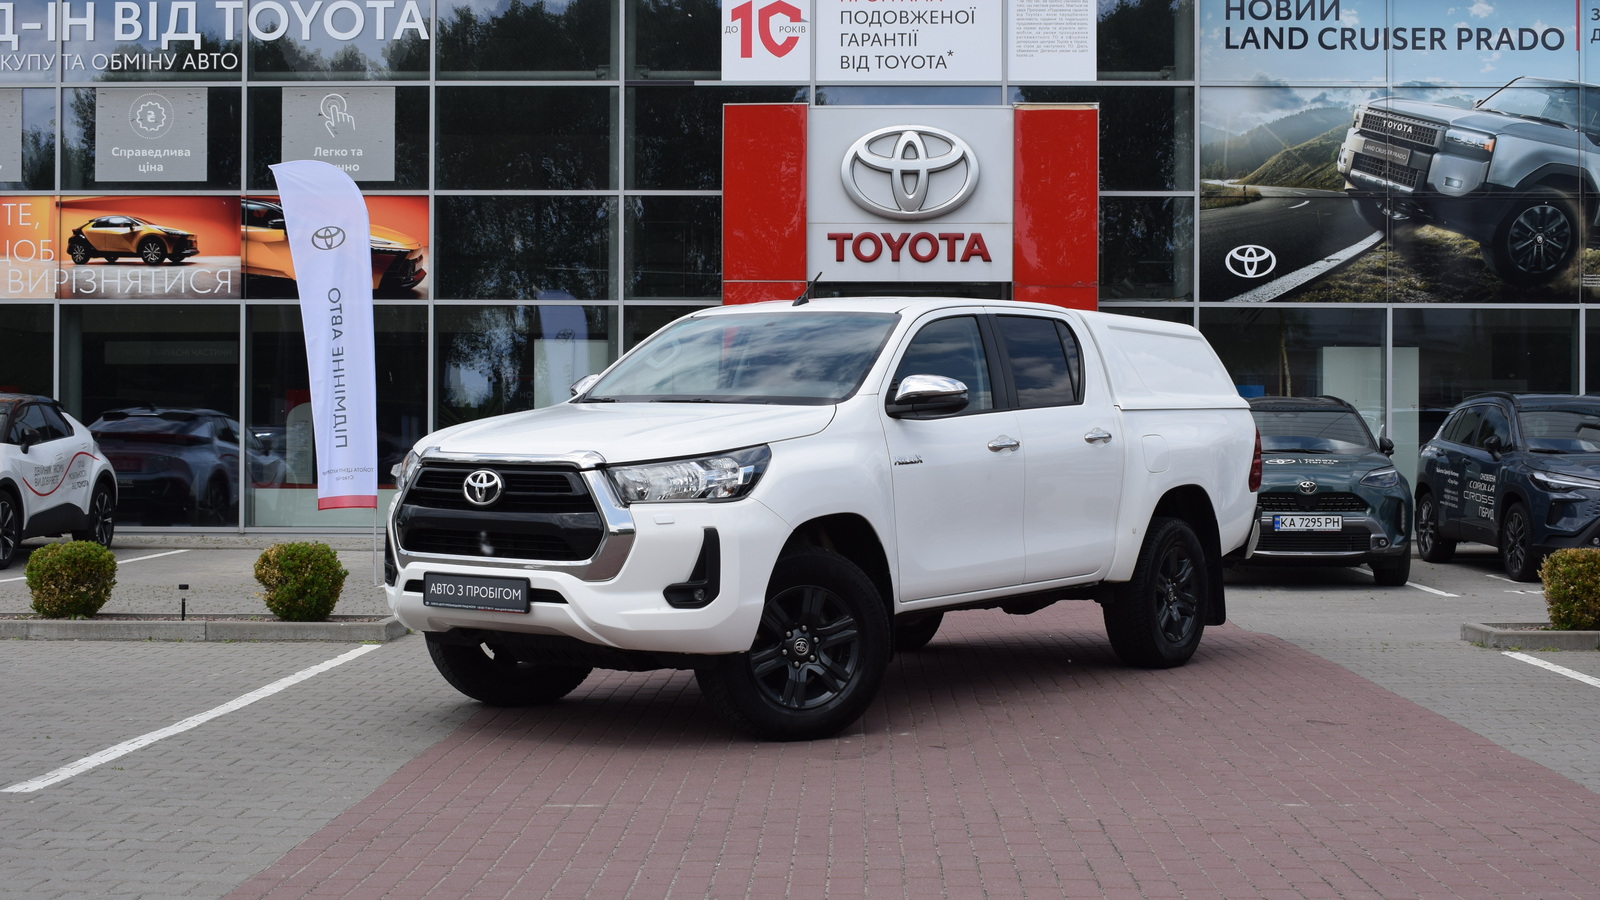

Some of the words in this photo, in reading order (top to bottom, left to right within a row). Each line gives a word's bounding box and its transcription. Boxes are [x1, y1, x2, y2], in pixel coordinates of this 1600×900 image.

[114, 2, 201, 50] ВІД
[215, 1, 429, 40] TOYOTA
[840, 7, 976, 27] ПОДОВЖЕНОЇ
[725, 26, 738, 34] ДО
[840, 30, 918, 47] ГАРАНТІЇ
[1225, 26, 1309, 50] LAND
[1318, 27, 1447, 51] CRUISER
[1457, 28, 1565, 51] PRADO
[1, 54, 55, 71] КУПУ
[62, 54, 85, 70] ТА
[92, 53, 176, 71] ОБМІНУ
[183, 53, 238, 70] АВТО
[840, 55, 870, 73] ВІД
[1383, 120, 1413, 134] TOYOTA
[112, 147, 191, 159] Справедлива
[314, 147, 348, 157] Легко
[350, 149, 363, 157] та
[139, 162, 164, 173] ціна
[2, 203, 39, 230] ТЕ,
[827, 232, 992, 263] TOYOTA
[8, 269, 232, 293] ВИРІЗНЯТИСЯ
[1469, 480, 1496, 493] COROLLA
[1463, 490, 1495, 505] CROSS
[1280, 518, 1296, 527] KA
[1299, 518, 1322, 527] 7295
[1325, 518, 1340, 527] PH
[430, 583, 456, 596] АВТО
[457, 585, 464, 596] З
[466, 585, 522, 601] ПРОБІГОМ
